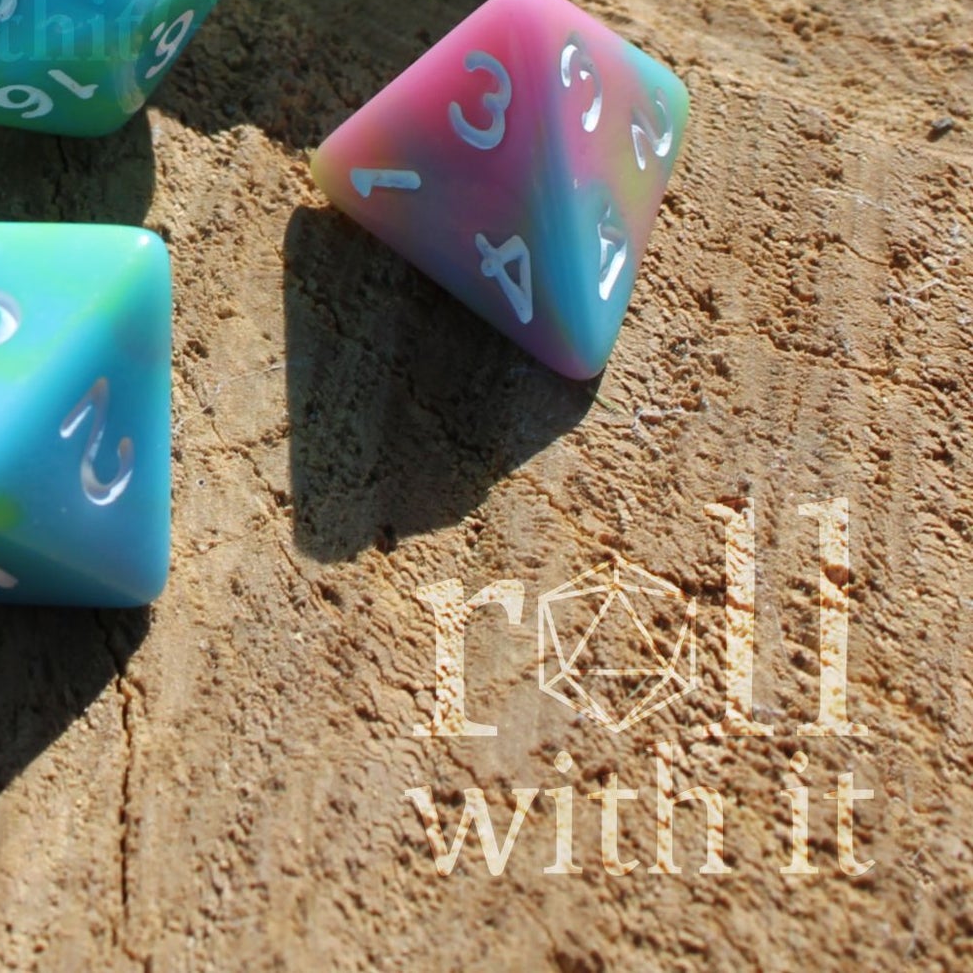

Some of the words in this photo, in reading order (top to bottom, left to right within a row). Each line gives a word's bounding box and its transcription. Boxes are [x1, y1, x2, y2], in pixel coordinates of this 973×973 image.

[448, 50, 512, 150] 3
[559, 31, 603, 132] 3
[631, 87, 673, 170] 2
[350, 167, 421, 198] 1
[475, 233, 533, 324] 4
[597, 201, 627, 301] 4
[59, 376, 134, 506] 2
